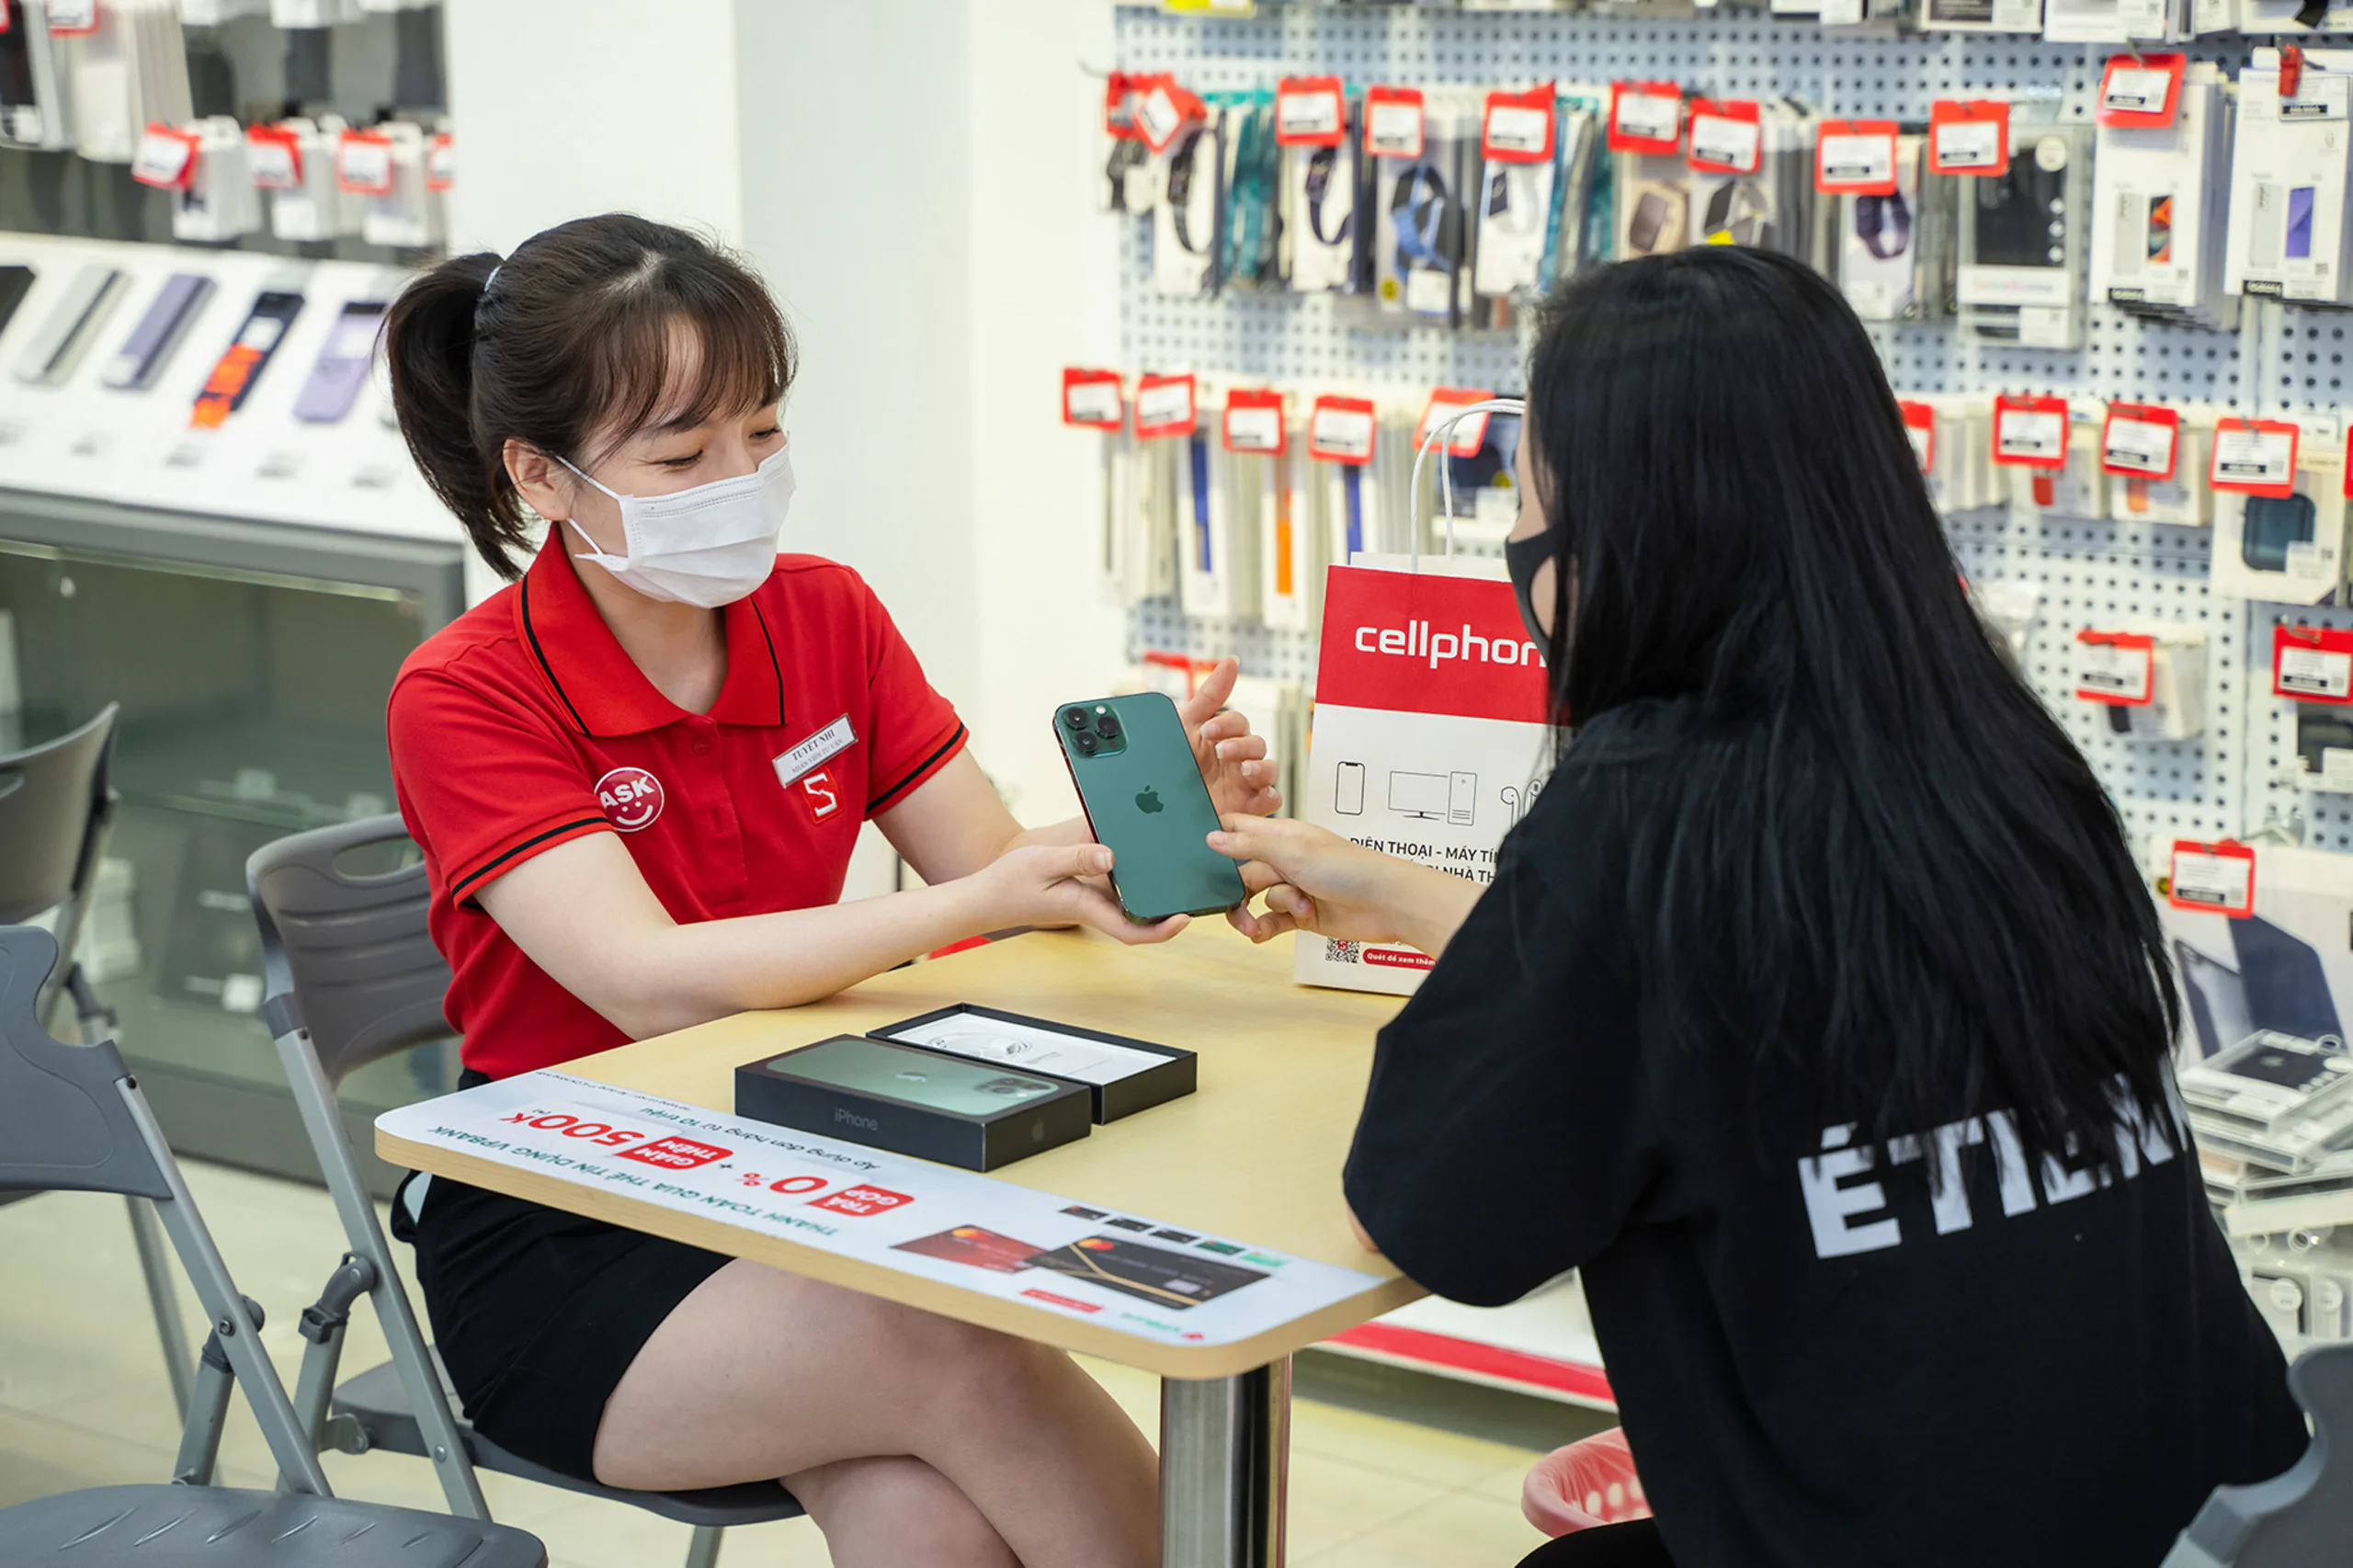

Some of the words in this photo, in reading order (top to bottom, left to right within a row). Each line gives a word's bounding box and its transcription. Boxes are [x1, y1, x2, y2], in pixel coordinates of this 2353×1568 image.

[599, 775, 655, 809] ASK
[1388, 840, 1433, 859] THOẠI
[1446, 845, 1478, 861] MÁY
[1398, 956, 1415, 964] xem
[679, 1117, 699, 1126] 10
[835, 1108, 878, 1131] iPhone
[427, 1125, 509, 1151] VPBANK
[511, 1146, 574, 1166] DỤNG
[807, 1147, 851, 1163] dụng
[572, 1163, 609, 1176] TÍN
[652, 1182, 699, 1199] QUA
[700, 1194, 764, 1216] TOÁN
[763, 1211, 839, 1236] THANH
